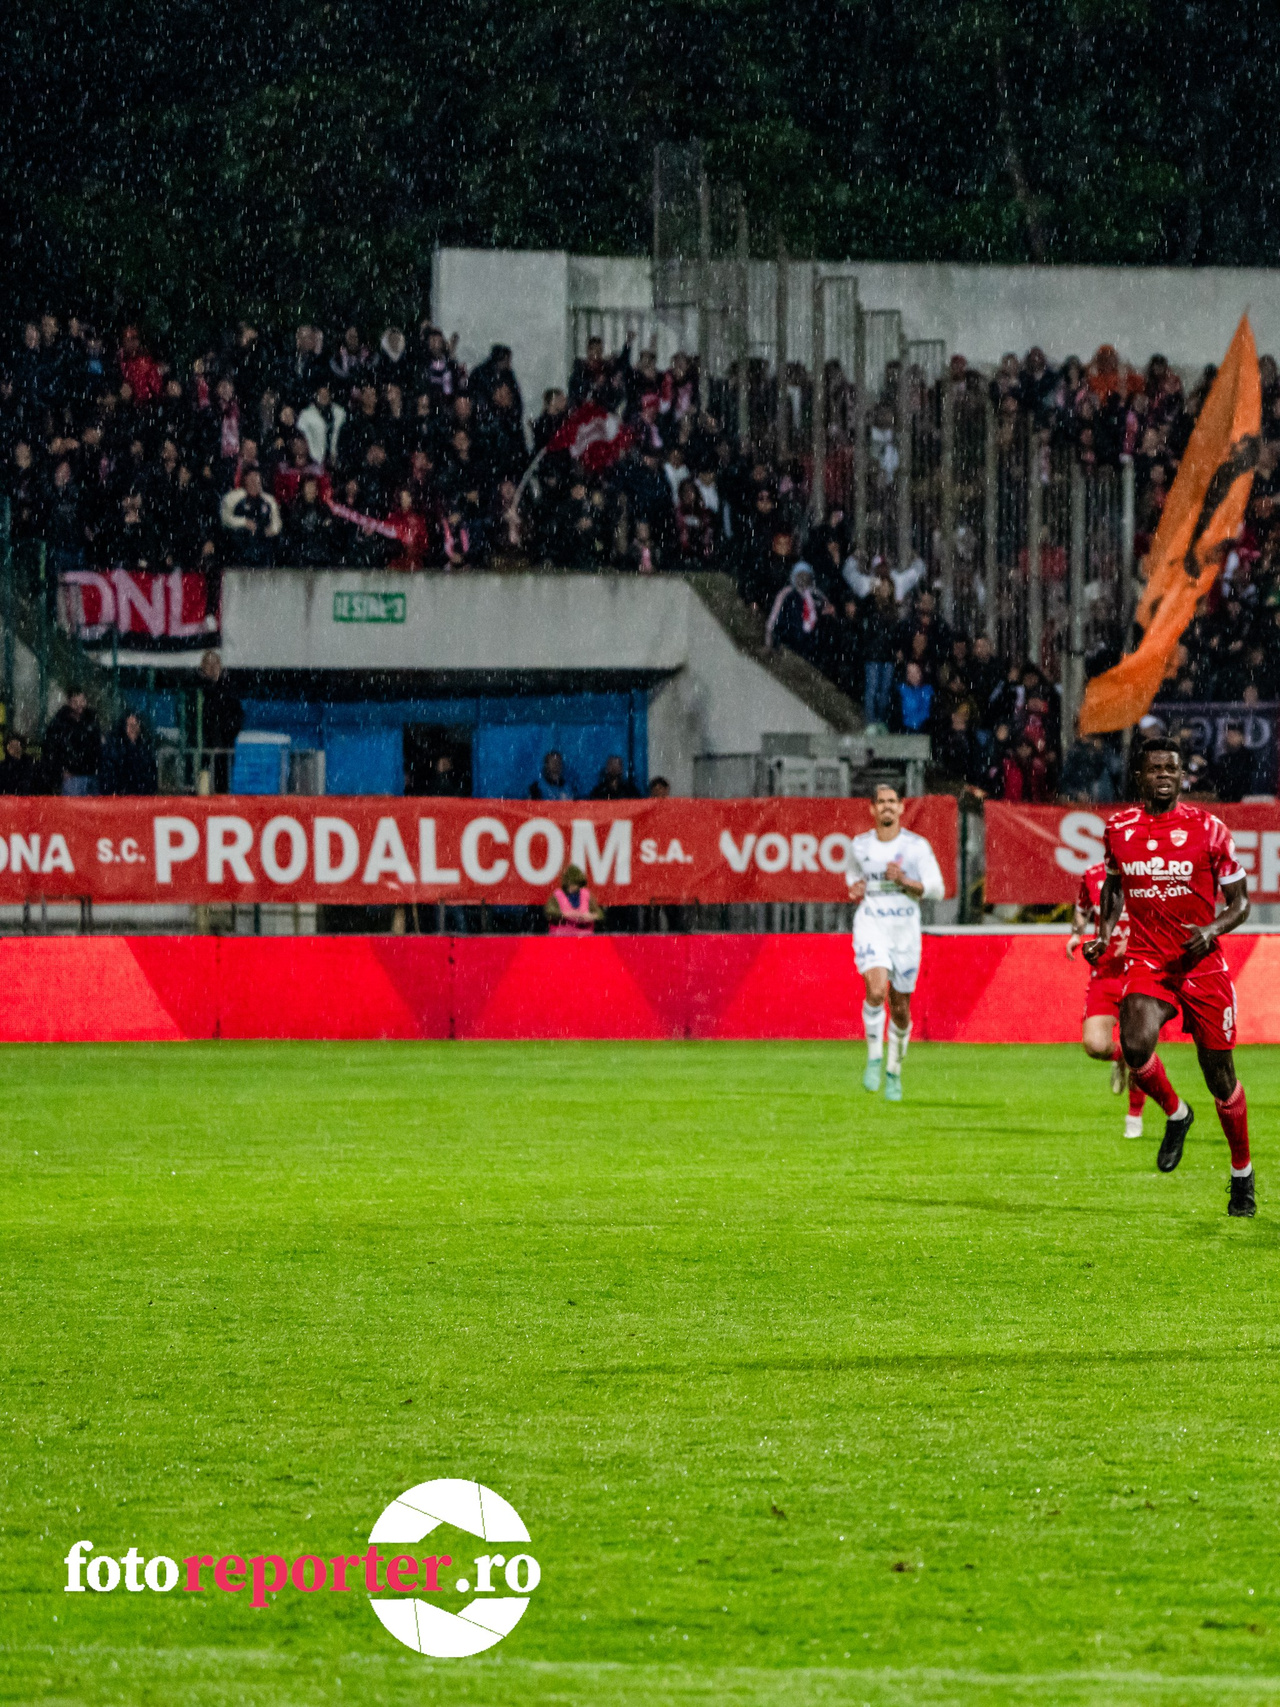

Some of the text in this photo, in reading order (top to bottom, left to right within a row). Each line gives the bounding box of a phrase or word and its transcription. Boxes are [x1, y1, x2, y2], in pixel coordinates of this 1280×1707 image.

[98, 816, 693, 885] S.C. PRODALCOM S.A.
[719, 830, 853, 873] VORO
[1122, 857, 1193, 876] WIN2.RO
